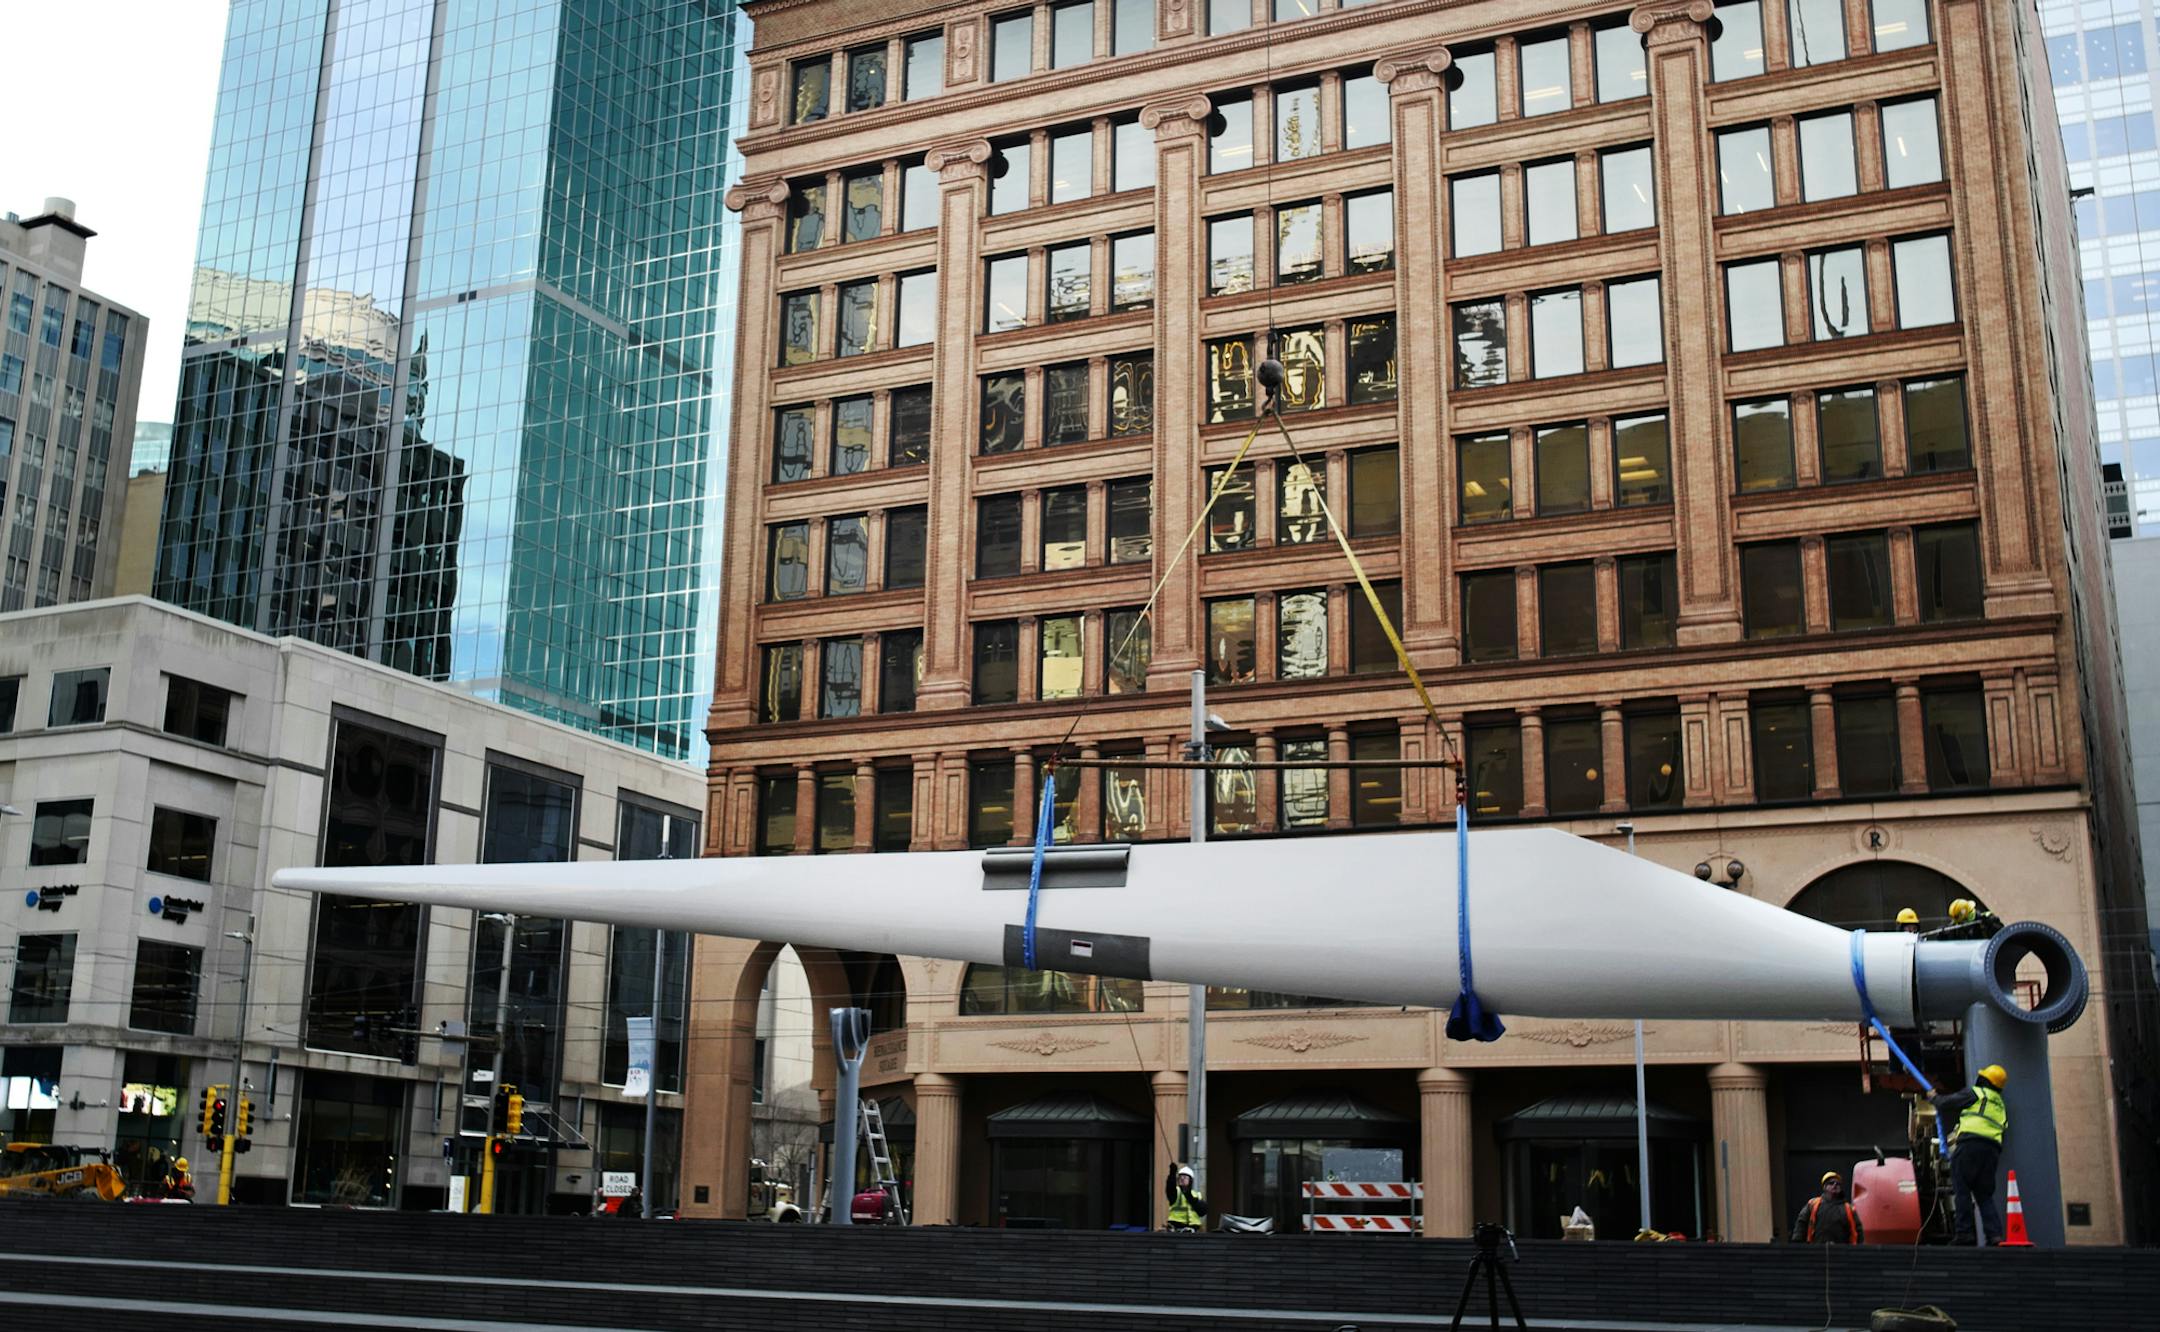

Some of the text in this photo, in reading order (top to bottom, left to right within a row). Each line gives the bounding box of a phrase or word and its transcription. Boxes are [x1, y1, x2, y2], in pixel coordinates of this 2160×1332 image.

[1869, 831, 1882, 848] R
[56, 1171, 83, 1185] JCB
[609, 1175, 629, 1184] ROAD
[605, 1185, 633, 1194] CLOSED
